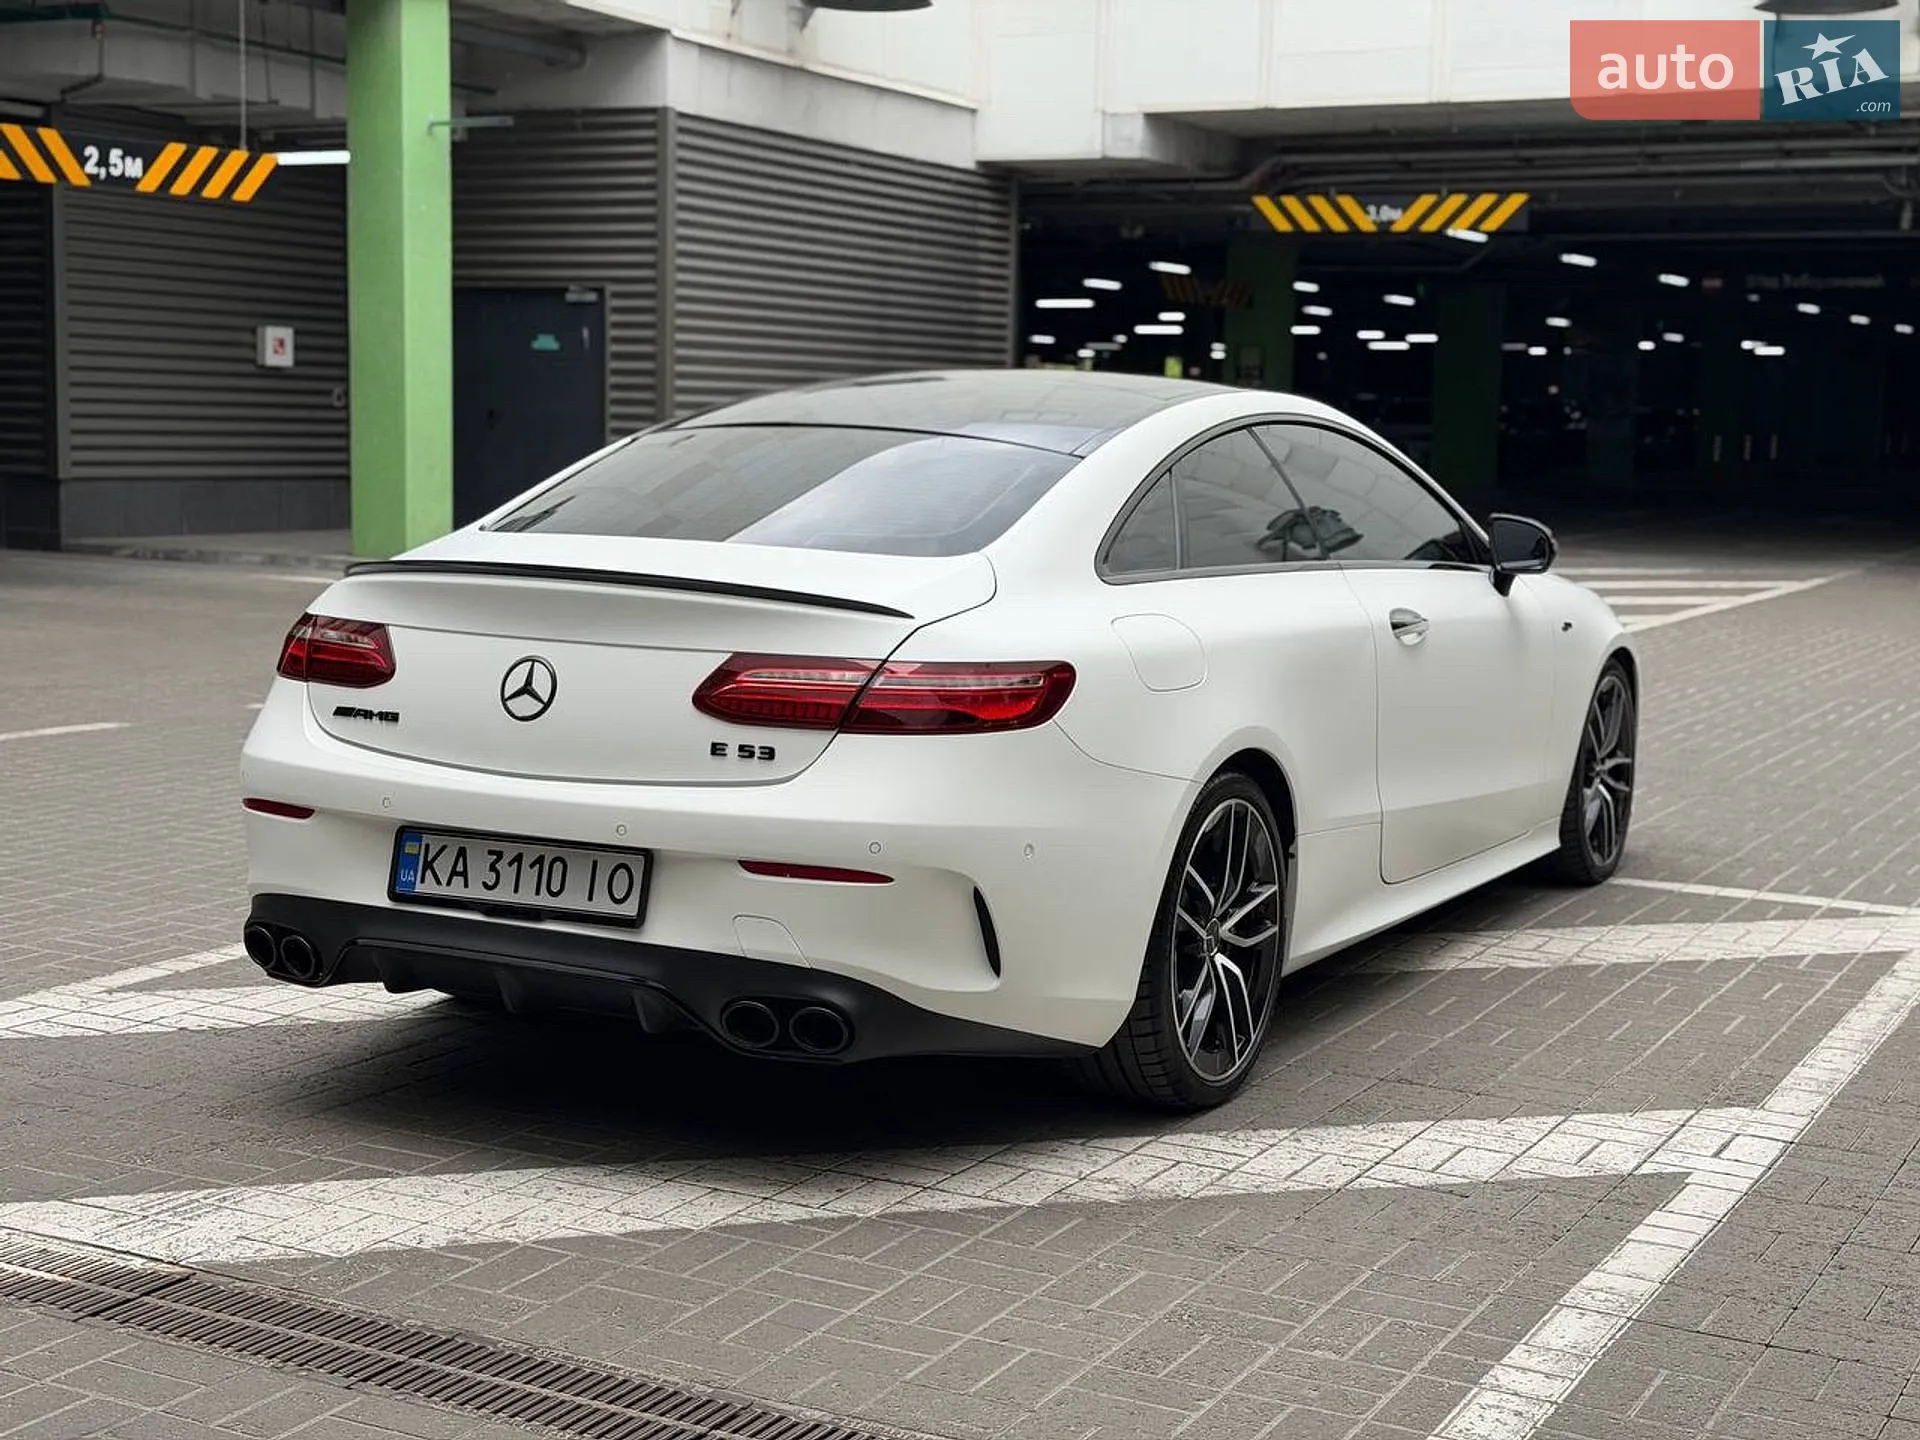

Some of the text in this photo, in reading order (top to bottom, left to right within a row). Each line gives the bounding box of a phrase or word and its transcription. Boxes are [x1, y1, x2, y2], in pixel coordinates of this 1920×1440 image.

[353, 708, 400, 722] AMG
[710, 742, 776, 761] E 53
[400, 870, 415, 883] UA
[420, 843, 469, 889] KA
[482, 850, 568, 898] 3110
